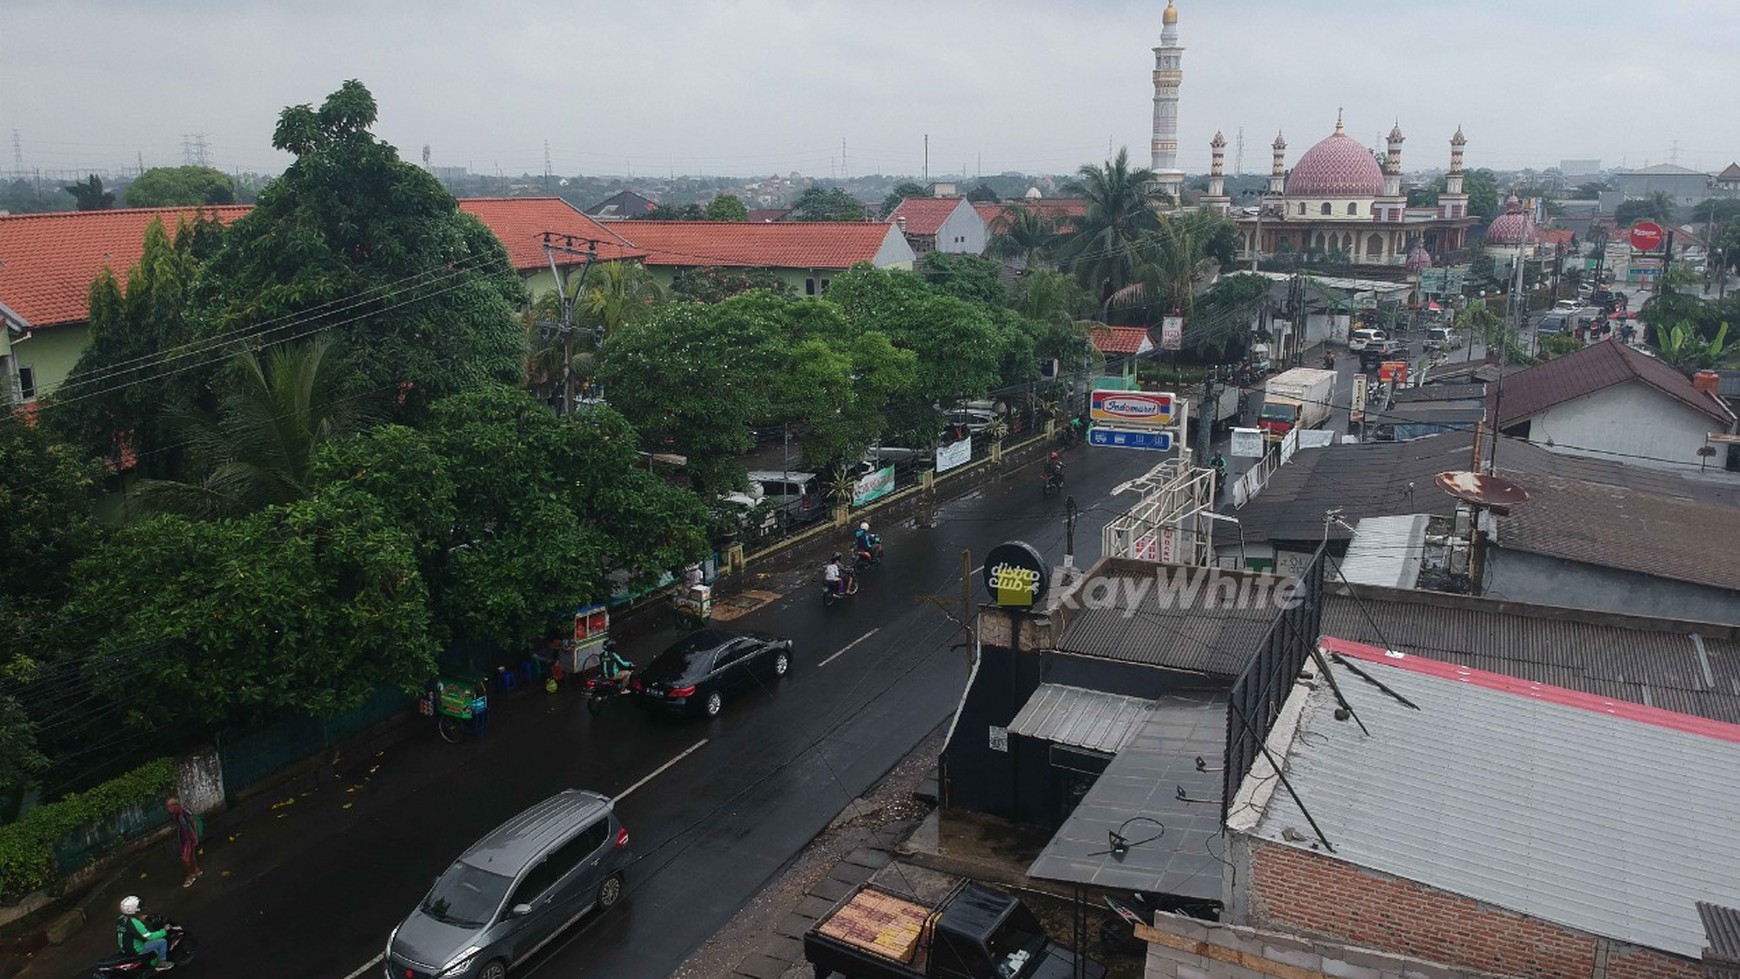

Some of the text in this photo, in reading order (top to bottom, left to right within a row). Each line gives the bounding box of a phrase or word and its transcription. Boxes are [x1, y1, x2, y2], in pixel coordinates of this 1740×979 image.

[1106, 401, 1156, 413] Indomaret
[991, 562, 1040, 581] distro
[988, 576, 1023, 591] club
